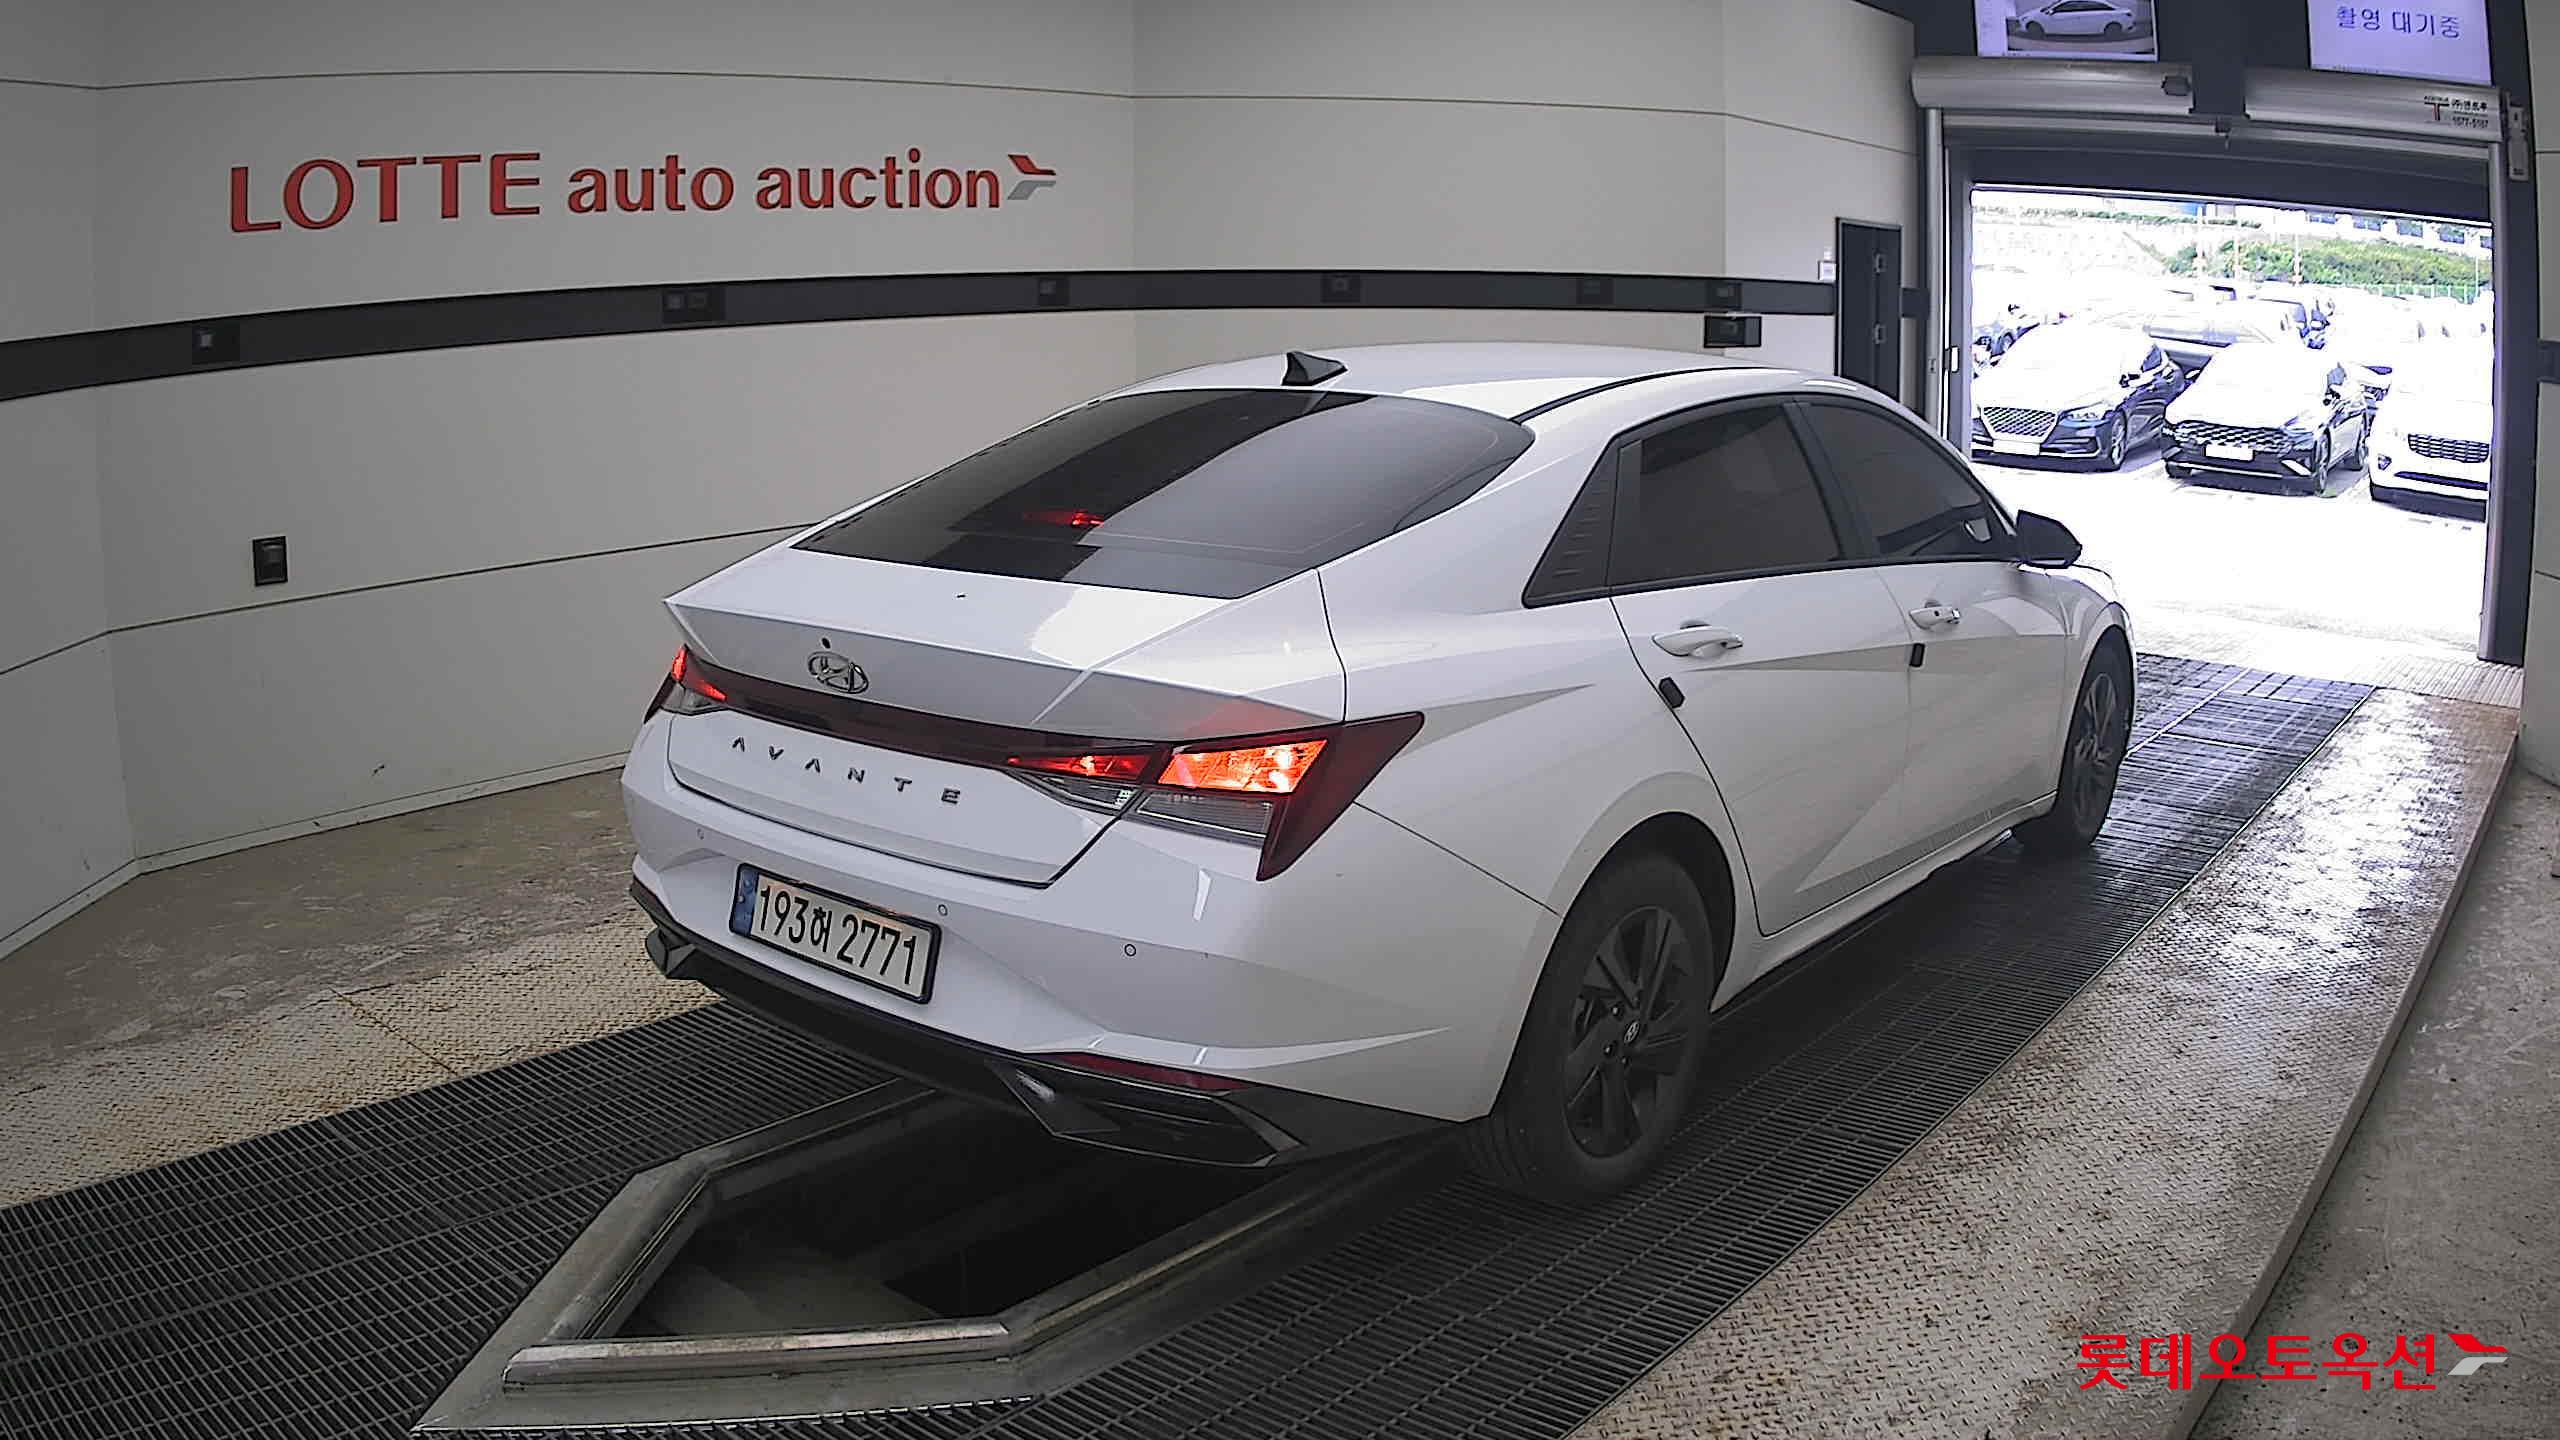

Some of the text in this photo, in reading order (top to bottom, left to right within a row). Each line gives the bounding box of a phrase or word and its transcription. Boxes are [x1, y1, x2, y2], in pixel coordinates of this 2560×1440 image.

[2337, 6, 2460, 39] 촬영 대기중
[231, 147, 1002, 232] LOTTE auto auction
[731, 736, 962, 805] AVANTE
